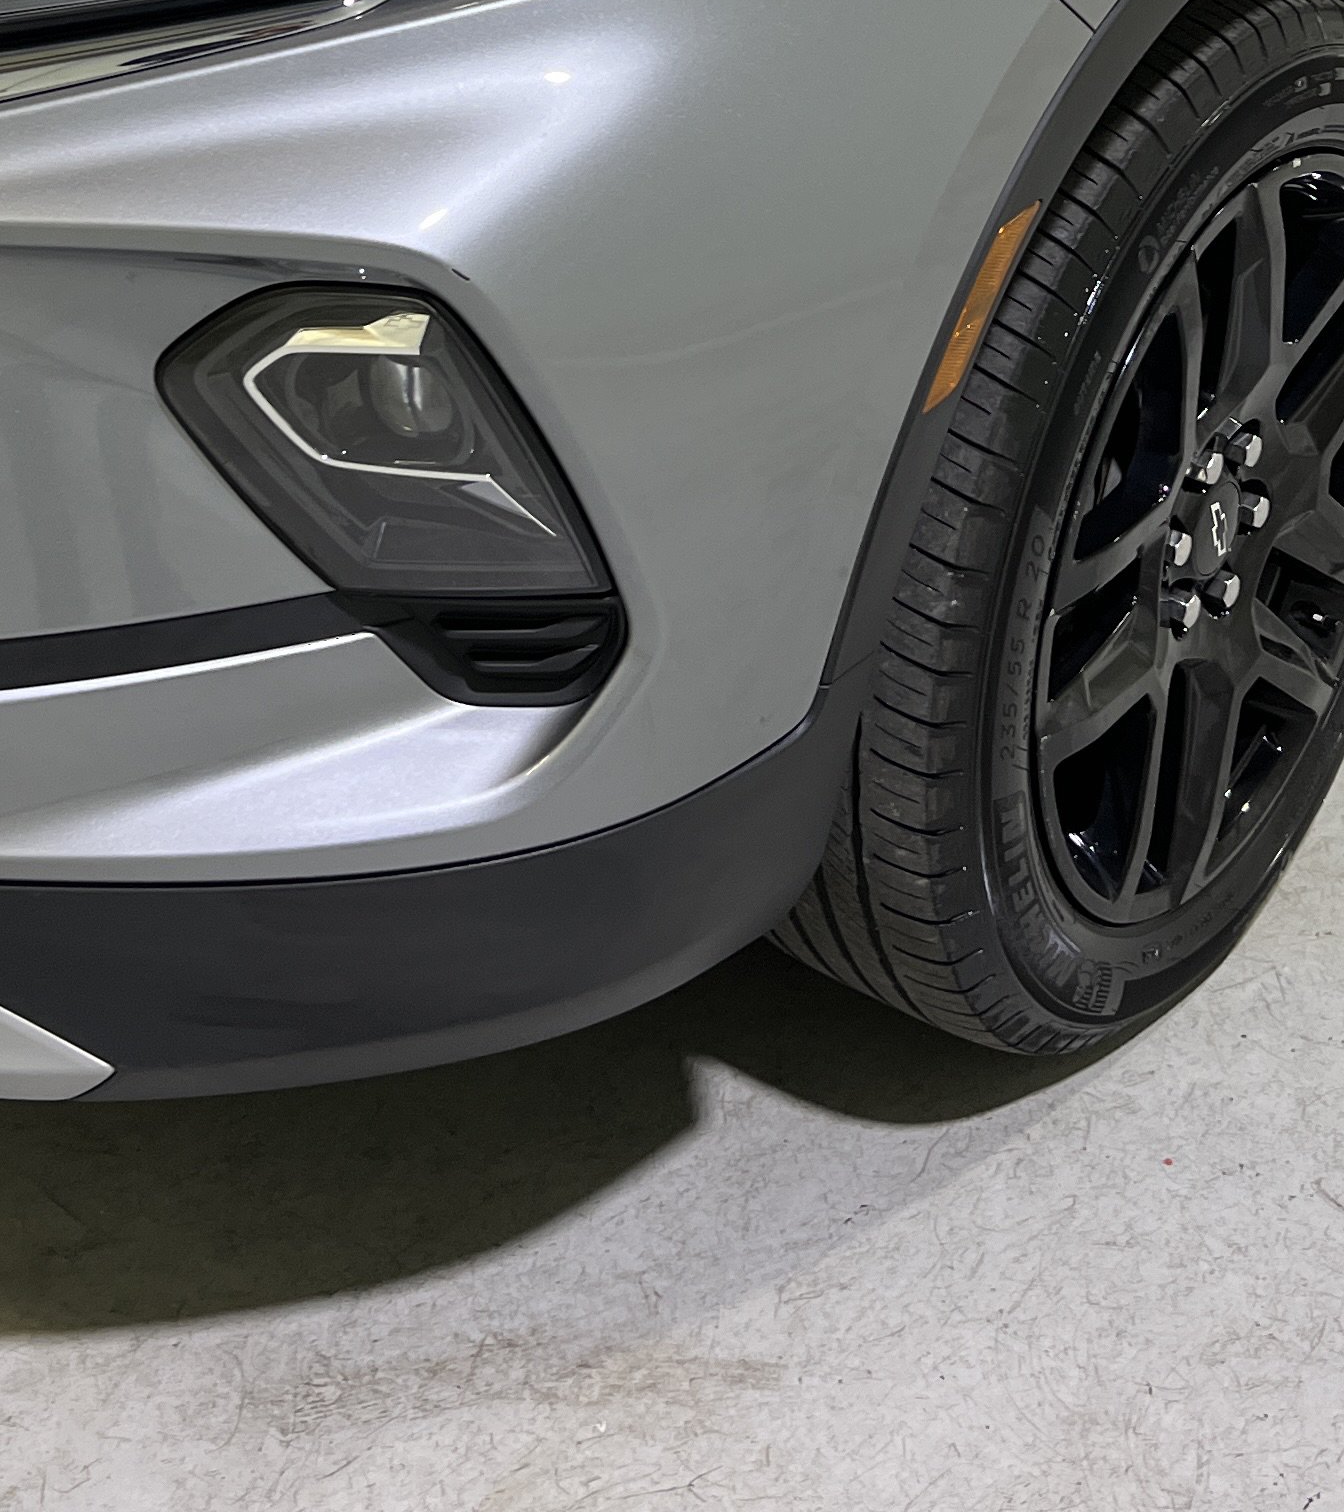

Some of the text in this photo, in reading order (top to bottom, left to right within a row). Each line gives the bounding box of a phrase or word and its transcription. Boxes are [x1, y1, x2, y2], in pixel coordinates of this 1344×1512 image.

[999, 637, 1026, 761] 235/55
[1025, 533, 1046, 584] 20
[1000, 806, 1082, 988] MICHELIN
